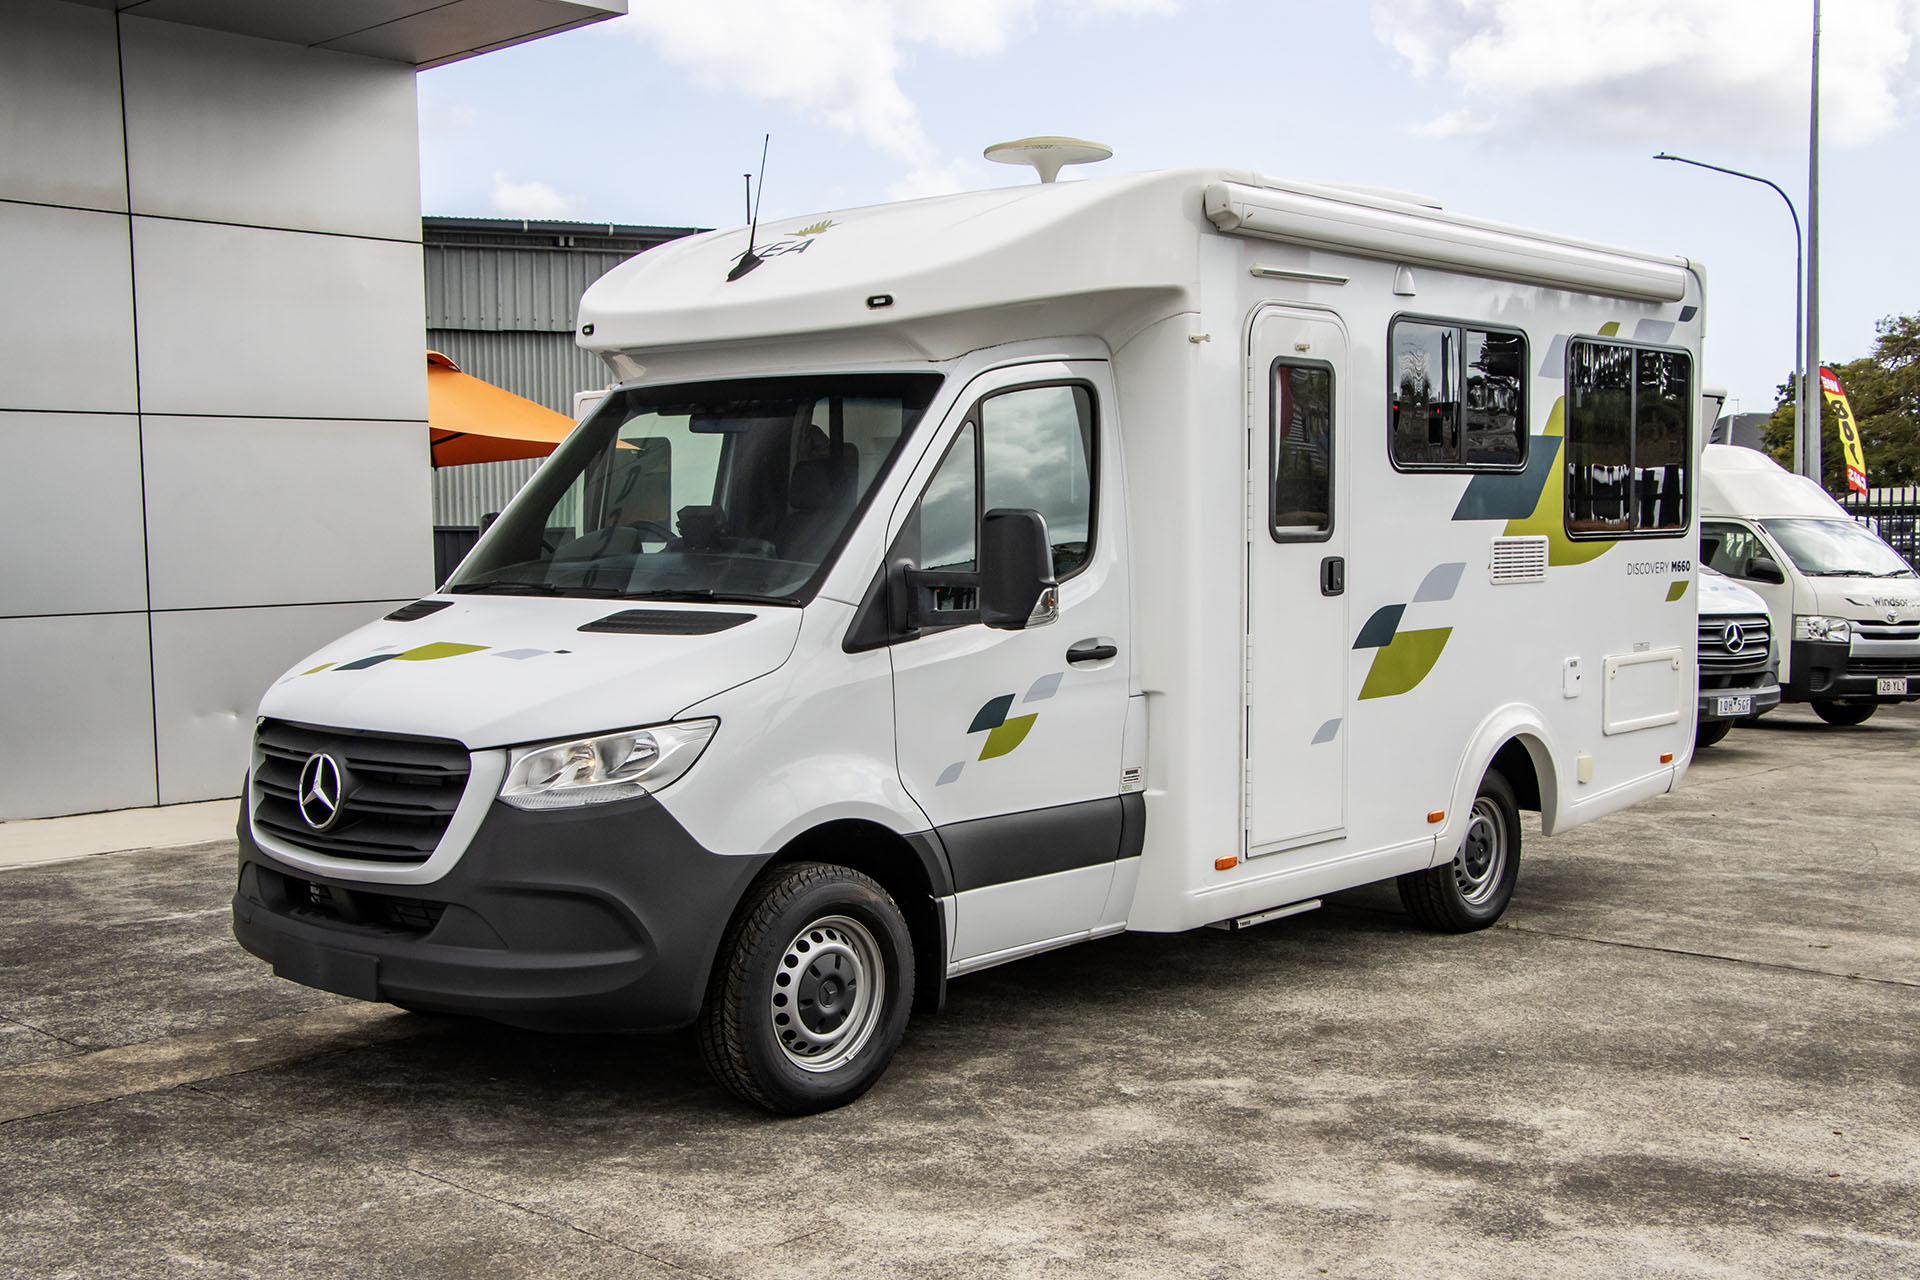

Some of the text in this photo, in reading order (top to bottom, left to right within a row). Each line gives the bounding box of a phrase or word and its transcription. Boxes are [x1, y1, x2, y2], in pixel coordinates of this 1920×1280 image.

[1626, 560, 1691, 575] DISCOVERY M660
[1872, 596, 1908, 607] Windsor
[1879, 680, 1906, 691] 128 YLY
